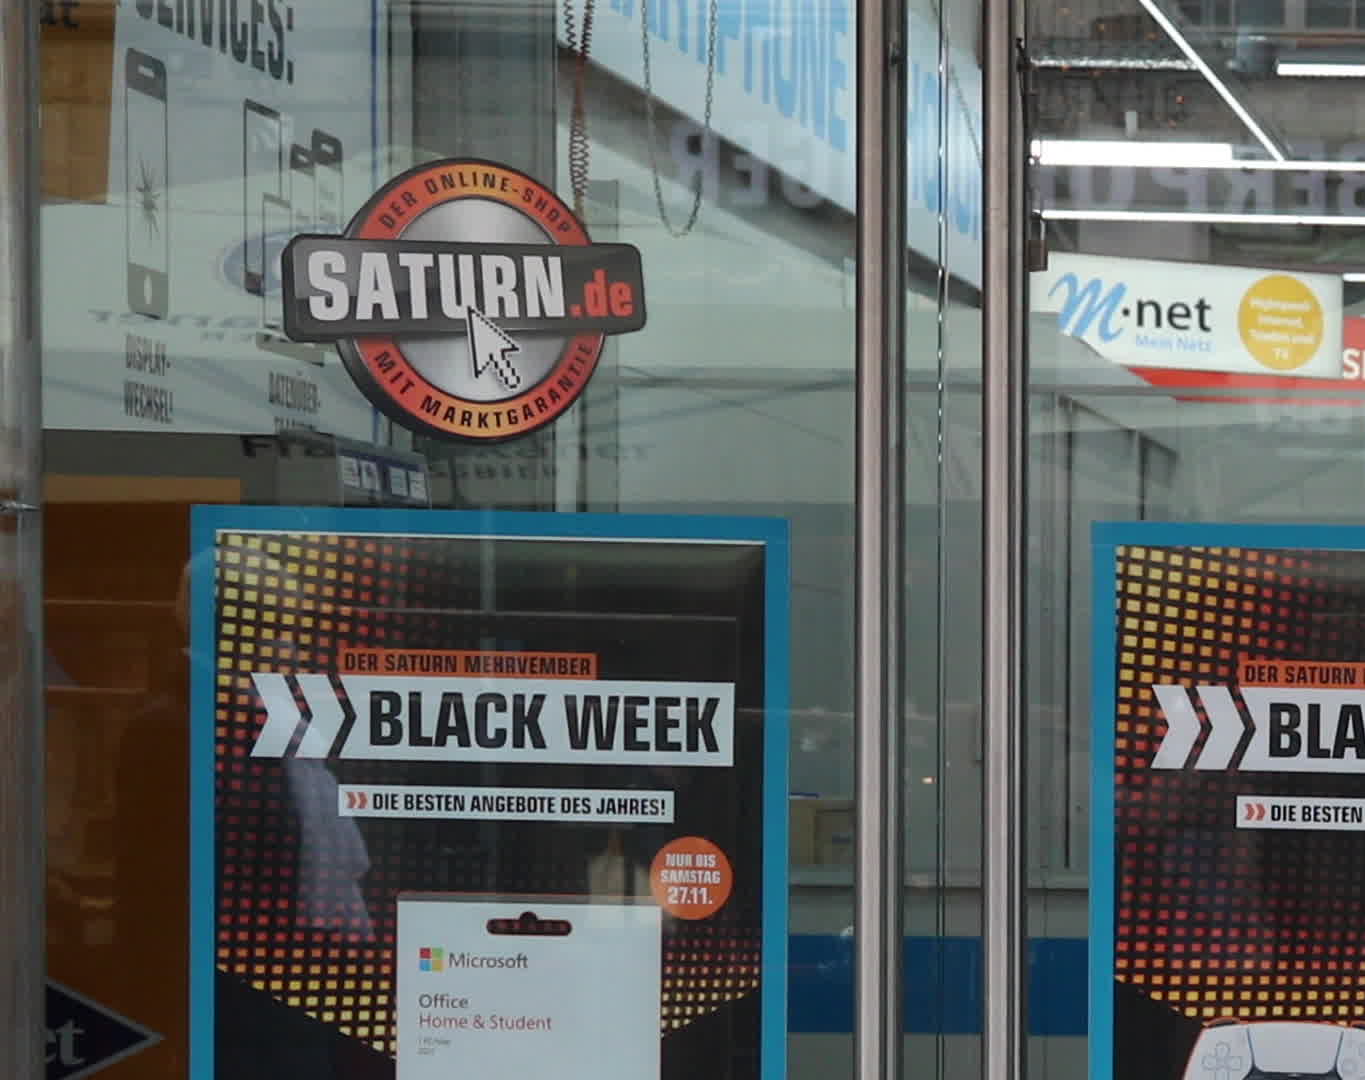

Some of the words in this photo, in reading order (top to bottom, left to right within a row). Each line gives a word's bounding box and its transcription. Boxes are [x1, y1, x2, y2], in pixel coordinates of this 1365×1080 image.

[136, 0, 293, 85] ICES:
[378, 194, 418, 230] DER
[424, 172, 571, 234] ONLINE-SHOP
[374, 350, 415, 395] MIT
[420, 343, 594, 429] MARKTGARANTIE
[344, 652, 379, 673] DER
[384, 653, 457, 674] SATURN
[463, 655, 592, 677] MEHRVEMBER
[1244, 665, 1278, 685] DER
[1284, 666, 1355, 687] SATURN
[369, 690, 548, 750] BLACK
[565, 695, 721, 754] WEEK
[372, 792, 399, 811] DIE
[403, 793, 466, 813] BESTEN
[470, 794, 556, 815] ANGEBOTE
[560, 796, 592, 816] DES
[596, 798, 667, 817] JAHRES!
[1271, 803, 1297, 822] DIE
[1302, 805, 1363, 824] BESTEN
[665, 852, 692, 868] NUR
[695, 852, 717, 868] BIS
[660, 868, 722, 886] SAMSTAG
[667, 886, 714, 905] 27.11.
[449, 951, 529, 970] Microsoft
[418, 993, 469, 1009] Office
[419, 1014, 468, 1030] Home
[473, 1015, 486, 1030] &
[490, 1014, 552, 1031] Student
